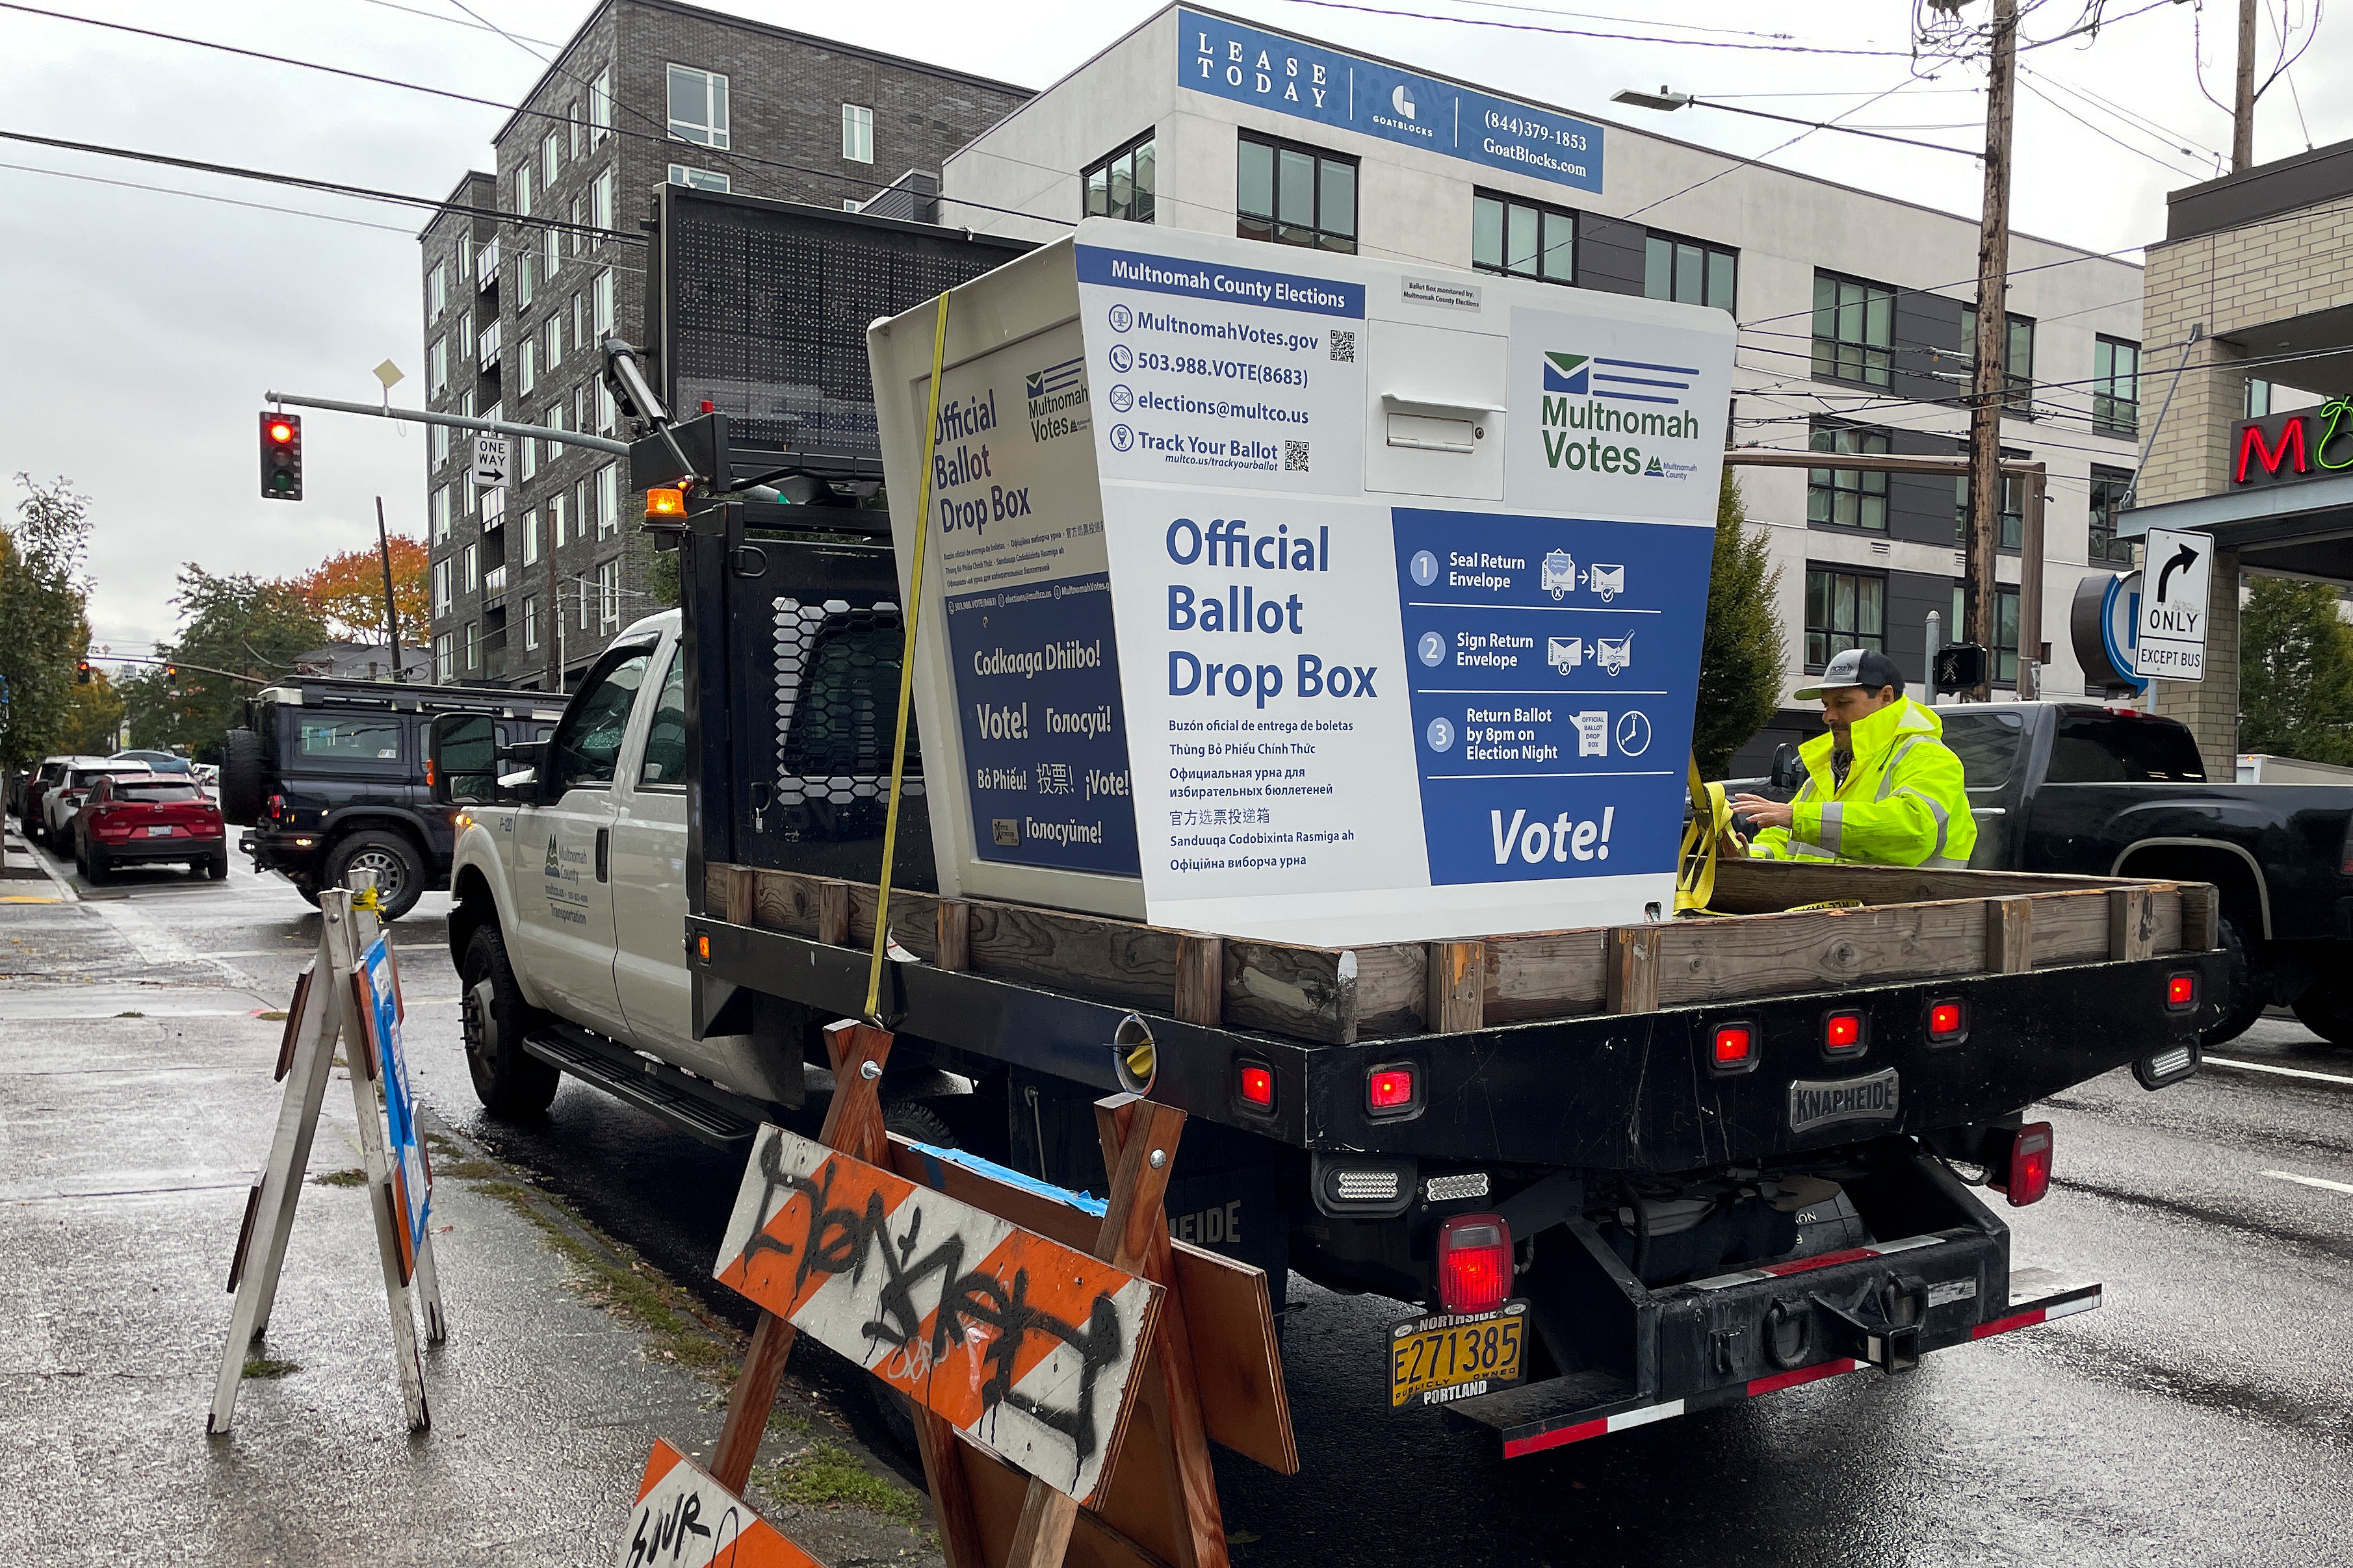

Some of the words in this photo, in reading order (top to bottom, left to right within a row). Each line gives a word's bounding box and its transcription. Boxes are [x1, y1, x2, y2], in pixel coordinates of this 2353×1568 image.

[1199, 32, 1327, 86] LEASE
[1198, 57, 1327, 109] TODAY
[1372, 114, 1433, 138] GOATBLOCKS
[1485, 109, 1587, 152] (844)379-1853
[1483, 138, 1587, 178] GoatBlocks.com
[1112, 260, 1210, 290] Multnomah
[1213, 275, 1272, 302] County
[1275, 283, 1346, 308] Elections
[1404, 291, 1435, 301] Multnomah
[1436, 296, 1454, 305] County
[1455, 298, 1479, 307] Elections
[1138, 312, 1318, 351] MultnomahVotes.gov
[1138, 353, 1308, 389] 503.988.VOTE(8683)
[1028, 384, 1089, 419] Multnomah
[1138, 392, 1309, 424] elections@multco.us
[1542, 395, 1698, 439] Multnomah
[1031, 417, 1068, 443] Votes
[480, 441, 505, 454] ONE
[1139, 432, 1185, 452] Track
[1188, 436, 1227, 456] Your
[1230, 440, 1278, 460] Ballot
[1542, 430, 1641, 475] Votes
[479, 454, 506, 467] WAY
[935, 444, 991, 490] Ballot
[1165, 454, 1278, 472] multco.us/trackyourballot
[1663, 462, 1697, 472] Multnomah
[1665, 471, 1687, 480] County
[941, 497, 987, 535] Drop
[991, 485, 1031, 521] Box
[1166, 518, 1329, 572] Official
[1419, 556, 1428, 578] 1
[1450, 552, 1478, 568] Seal
[1481, 553, 1526, 570] Return
[1450, 571, 1511, 591] Envelope
[1168, 585, 1303, 634] Ballot
[2150, 610, 2198, 633] ONLY
[1425, 637, 1438, 660] 2
[1457, 632, 1487, 650] Sign
[1489, 633, 1533, 649] Return
[974, 647, 1043, 679] Codkaaga
[1045, 639, 1101, 671] Dhiibo!
[1457, 652, 1518, 670] Envelope
[2141, 649, 2178, 665] EXCEPT
[2181, 651, 2200, 667] BUS
[1169, 650, 1283, 709] Drop
[1297, 654, 1378, 698] Box
[976, 701, 1028, 739] Vote!
[1046, 705, 1112, 740] Голосуй!
[1169, 720, 1203, 731] Buzón
[1206, 720, 1238, 731] oficial
[1242, 720, 1254, 731] de
[1257, 721, 1297, 733] entrega
[1300, 719, 1314, 731] de
[1316, 719, 1353, 731] boletas
[1466, 708, 1511, 723] Return
[1514, 708, 1552, 723] Ballot
[1435, 724, 1448, 745] 3
[1466, 727, 1483, 743] by
[1486, 727, 1515, 743] 8pm
[1518, 730, 1535, 741] on
[1169, 743, 1205, 758] Thùng
[1208, 743, 1222, 755] Bỏ
[1225, 741, 1255, 755] Phiếu
[1258, 743, 1288, 754] Chính
[1290, 742, 1316, 754] Thức
[1466, 745, 1520, 760] Election
[1522, 745, 1558, 763] Night
[978, 767, 992, 790] Bỏ
[993, 766, 1027, 791] Phiếu!
[1036, 762, 1075, 795] 投票!
[1086, 769, 1130, 801] ¡Vote!
[1169, 767, 1252, 782] Официальная
[1254, 769, 1282, 781] урна
[1284, 768, 1305, 780] для
[1169, 786, 1262, 799] избирательных
[1265, 783, 1333, 796] бюллетеней
[1169, 807, 1269, 827] 官方选票投递箱
[1026, 816, 1102, 847] Голосуйте!
[1170, 835, 1226, 847] Sanduuqa
[1228, 832, 1294, 844] Codobixinta
[1296, 830, 1340, 843] Rasmiga
[1342, 829, 1354, 841] ah
[1490, 806, 1615, 864] Vote!
[558, 845, 587, 864] Multnomah
[1170, 858, 1225, 873] Офіційна
[1228, 856, 1277, 869] виборча
[1280, 856, 1306, 868] урна
[561, 864, 579, 886] County
[551, 903, 586, 925] Transportation
[1796, 1075, 1894, 1124] KNAPHEIDE
[1395, 1323, 1520, 1385] E271385
[1474, 1367, 1516, 1380] OWNED
[1396, 1378, 1450, 1400] PUBLICLY
[1424, 1380, 1487, 1406] PORTLAND
